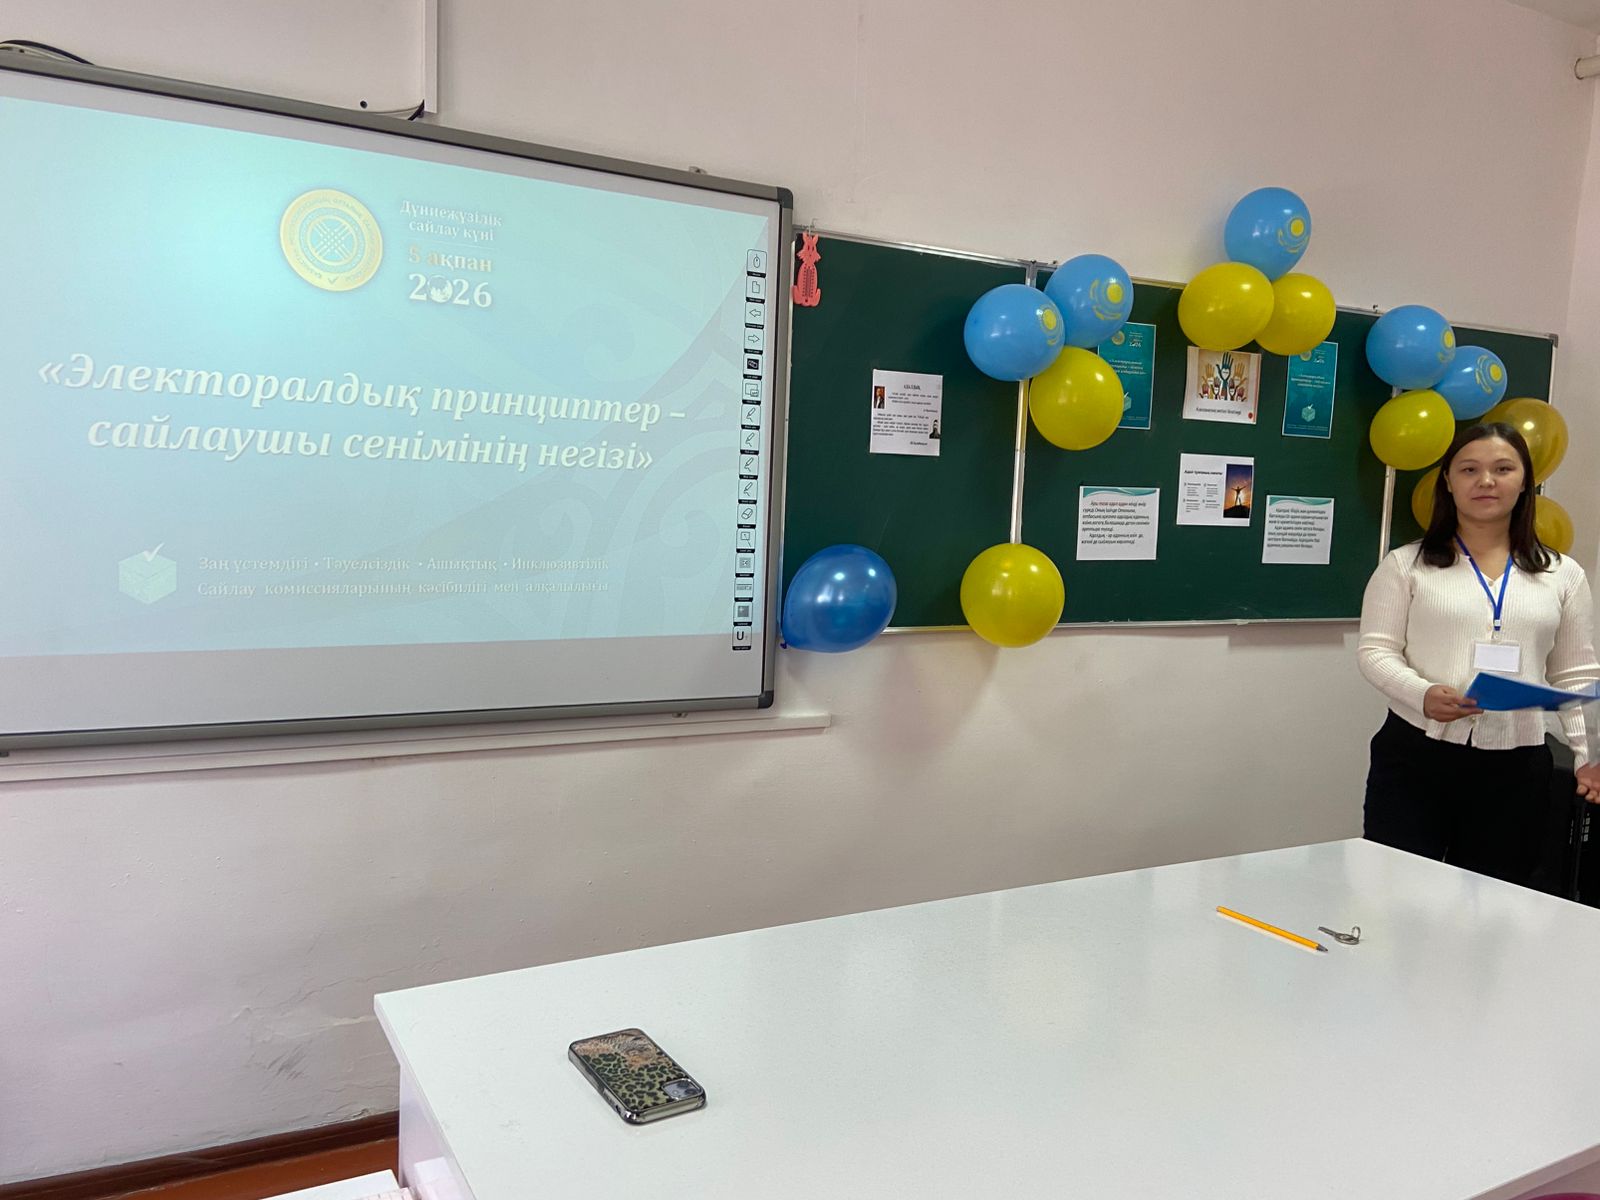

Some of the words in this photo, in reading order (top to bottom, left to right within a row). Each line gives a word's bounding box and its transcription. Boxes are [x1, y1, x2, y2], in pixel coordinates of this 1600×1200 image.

[400, 200, 502, 227] Дүниежүзілік
[409, 220, 459, 239] сайлау
[463, 228, 493, 242] күні
[427, 251, 491, 272] ақпан
[408, 273, 492, 307] 2026
[38, 352, 422, 416] «Электоралдық
[431, 385, 661, 431] принциптер
[87, 414, 332, 462] сайлаушы
[343, 430, 529, 472] сенімінің
[538, 440, 653, 470] негізі»
[199, 556, 230, 572] Заң
[233, 556, 309, 573] үстемдігі
[322, 556, 410, 573] Тәуелсіздік
[426, 557, 498, 572] Ашықтық
[198, 582, 256, 597] Сайлау
[264, 582, 412, 598] комиссияларының
[418, 581, 488, 594] кәсібилігі
[494, 583, 519, 593] мен
